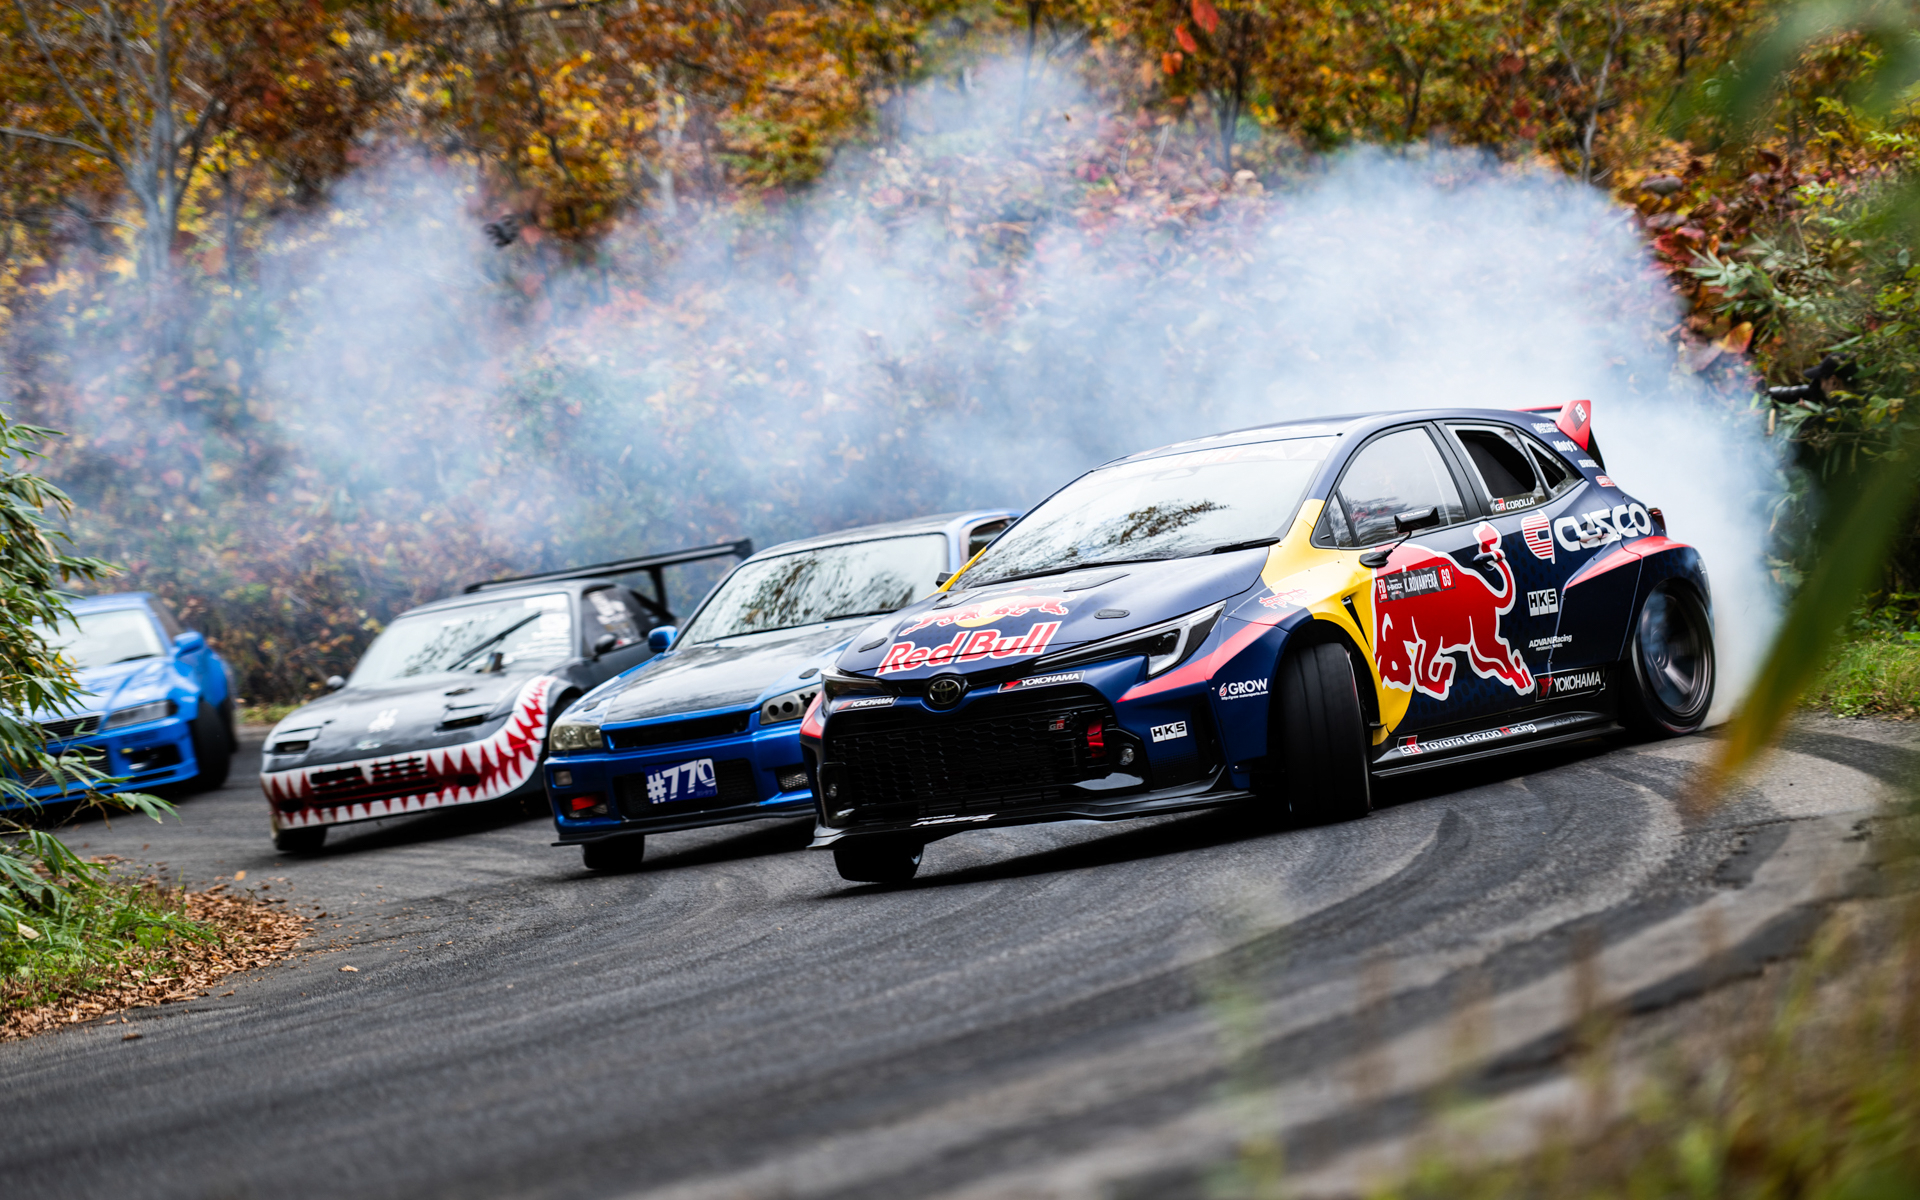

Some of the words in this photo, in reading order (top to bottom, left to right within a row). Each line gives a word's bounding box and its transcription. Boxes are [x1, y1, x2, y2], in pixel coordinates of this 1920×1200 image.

[1506, 497, 1536, 510] COROLLA
[1553, 502, 1652, 552] CUSCO
[1441, 568, 1452, 587] 69
[1528, 590, 1557, 609] HKS
[874, 631, 971, 676] Red
[955, 621, 1063, 663] Bull
[1021, 672, 1080, 686] YOKOHAMA
[1228, 678, 1268, 695] GROW
[1553, 671, 1602, 692] YOKOHAMA
[850, 697, 895, 708] YOKOHAMA
[1152, 722, 1186, 738] HKS
[1422, 737, 1465, 751] TOYOTA
[1466, 730, 1502, 744] GAZOO
[1500, 723, 1538, 736] Racing
[646, 758, 717, 805] #770
